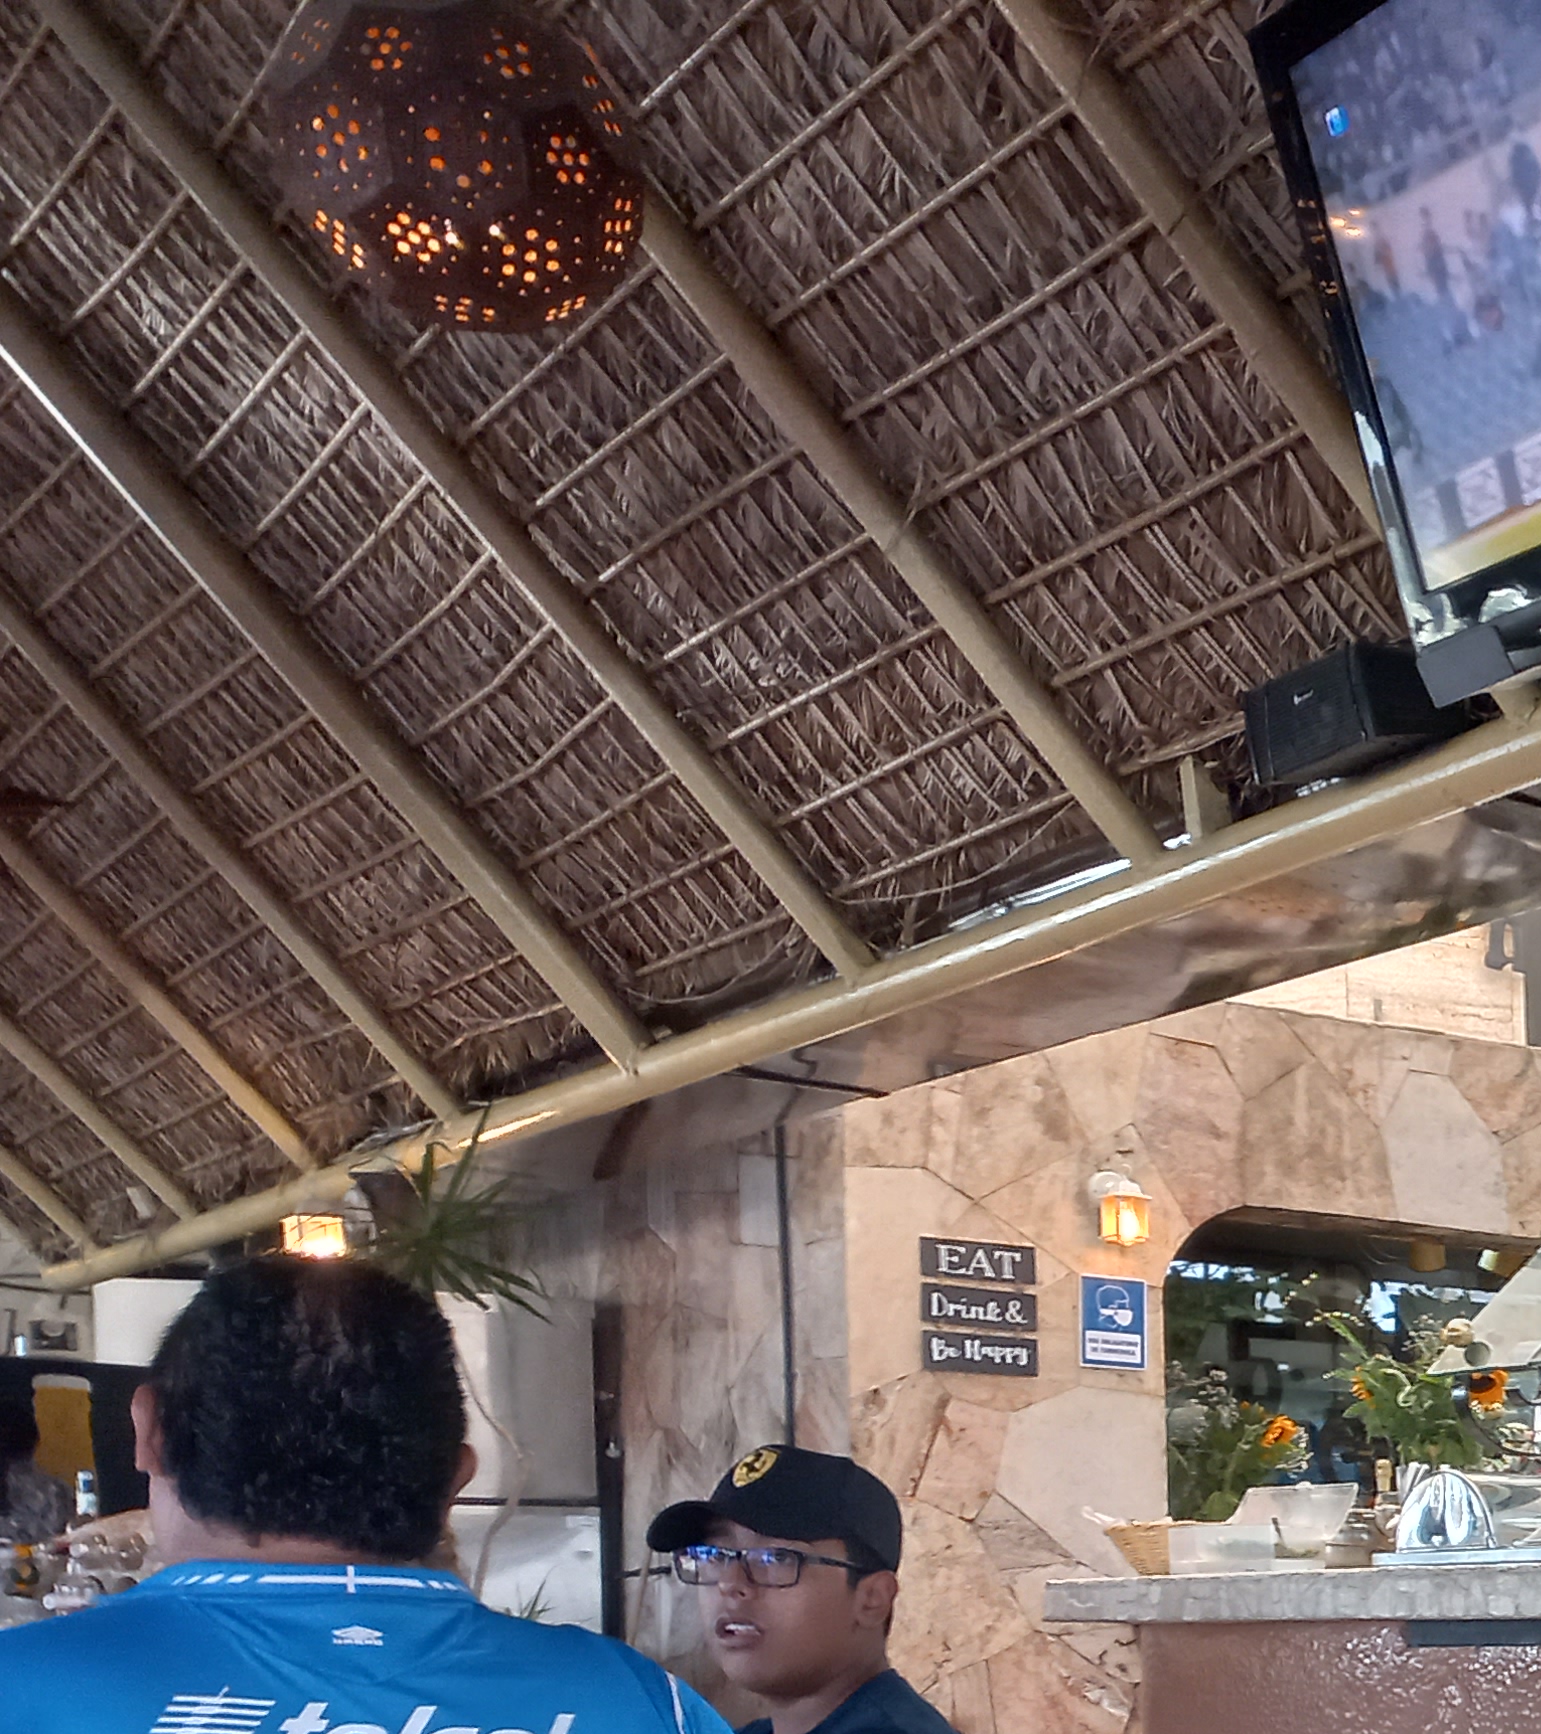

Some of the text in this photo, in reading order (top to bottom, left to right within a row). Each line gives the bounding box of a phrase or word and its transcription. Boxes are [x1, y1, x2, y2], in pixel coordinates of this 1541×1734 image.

[935, 1244, 1021, 1279] EAT
[930, 1291, 1028, 1324] Drink &
[930, 1337, 1029, 1366] Be Happy
